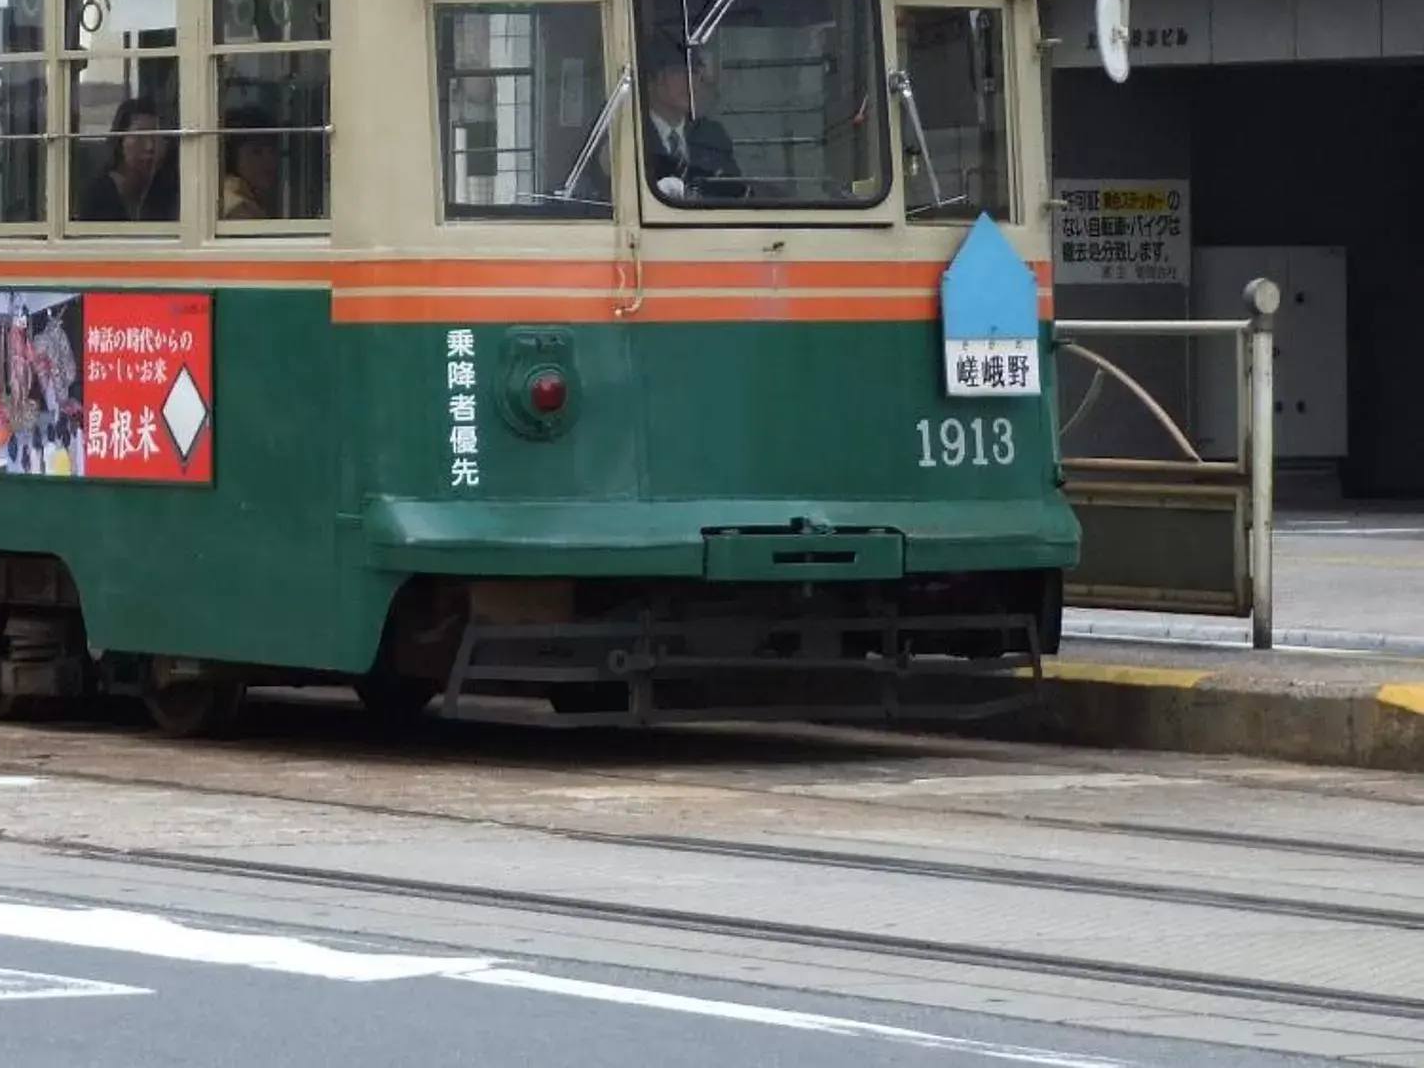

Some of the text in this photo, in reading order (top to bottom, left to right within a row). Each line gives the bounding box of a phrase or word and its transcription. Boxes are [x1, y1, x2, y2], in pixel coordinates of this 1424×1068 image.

[87, 326, 193, 354] 神話の時代からの
[88, 358, 168, 383] おいしいお米
[956, 354, 1030, 388] 嵯峨野
[446, 329, 480, 486] 乗降者優先
[86, 404, 160, 461] 島根米
[916, 417, 1016, 466] 1913
